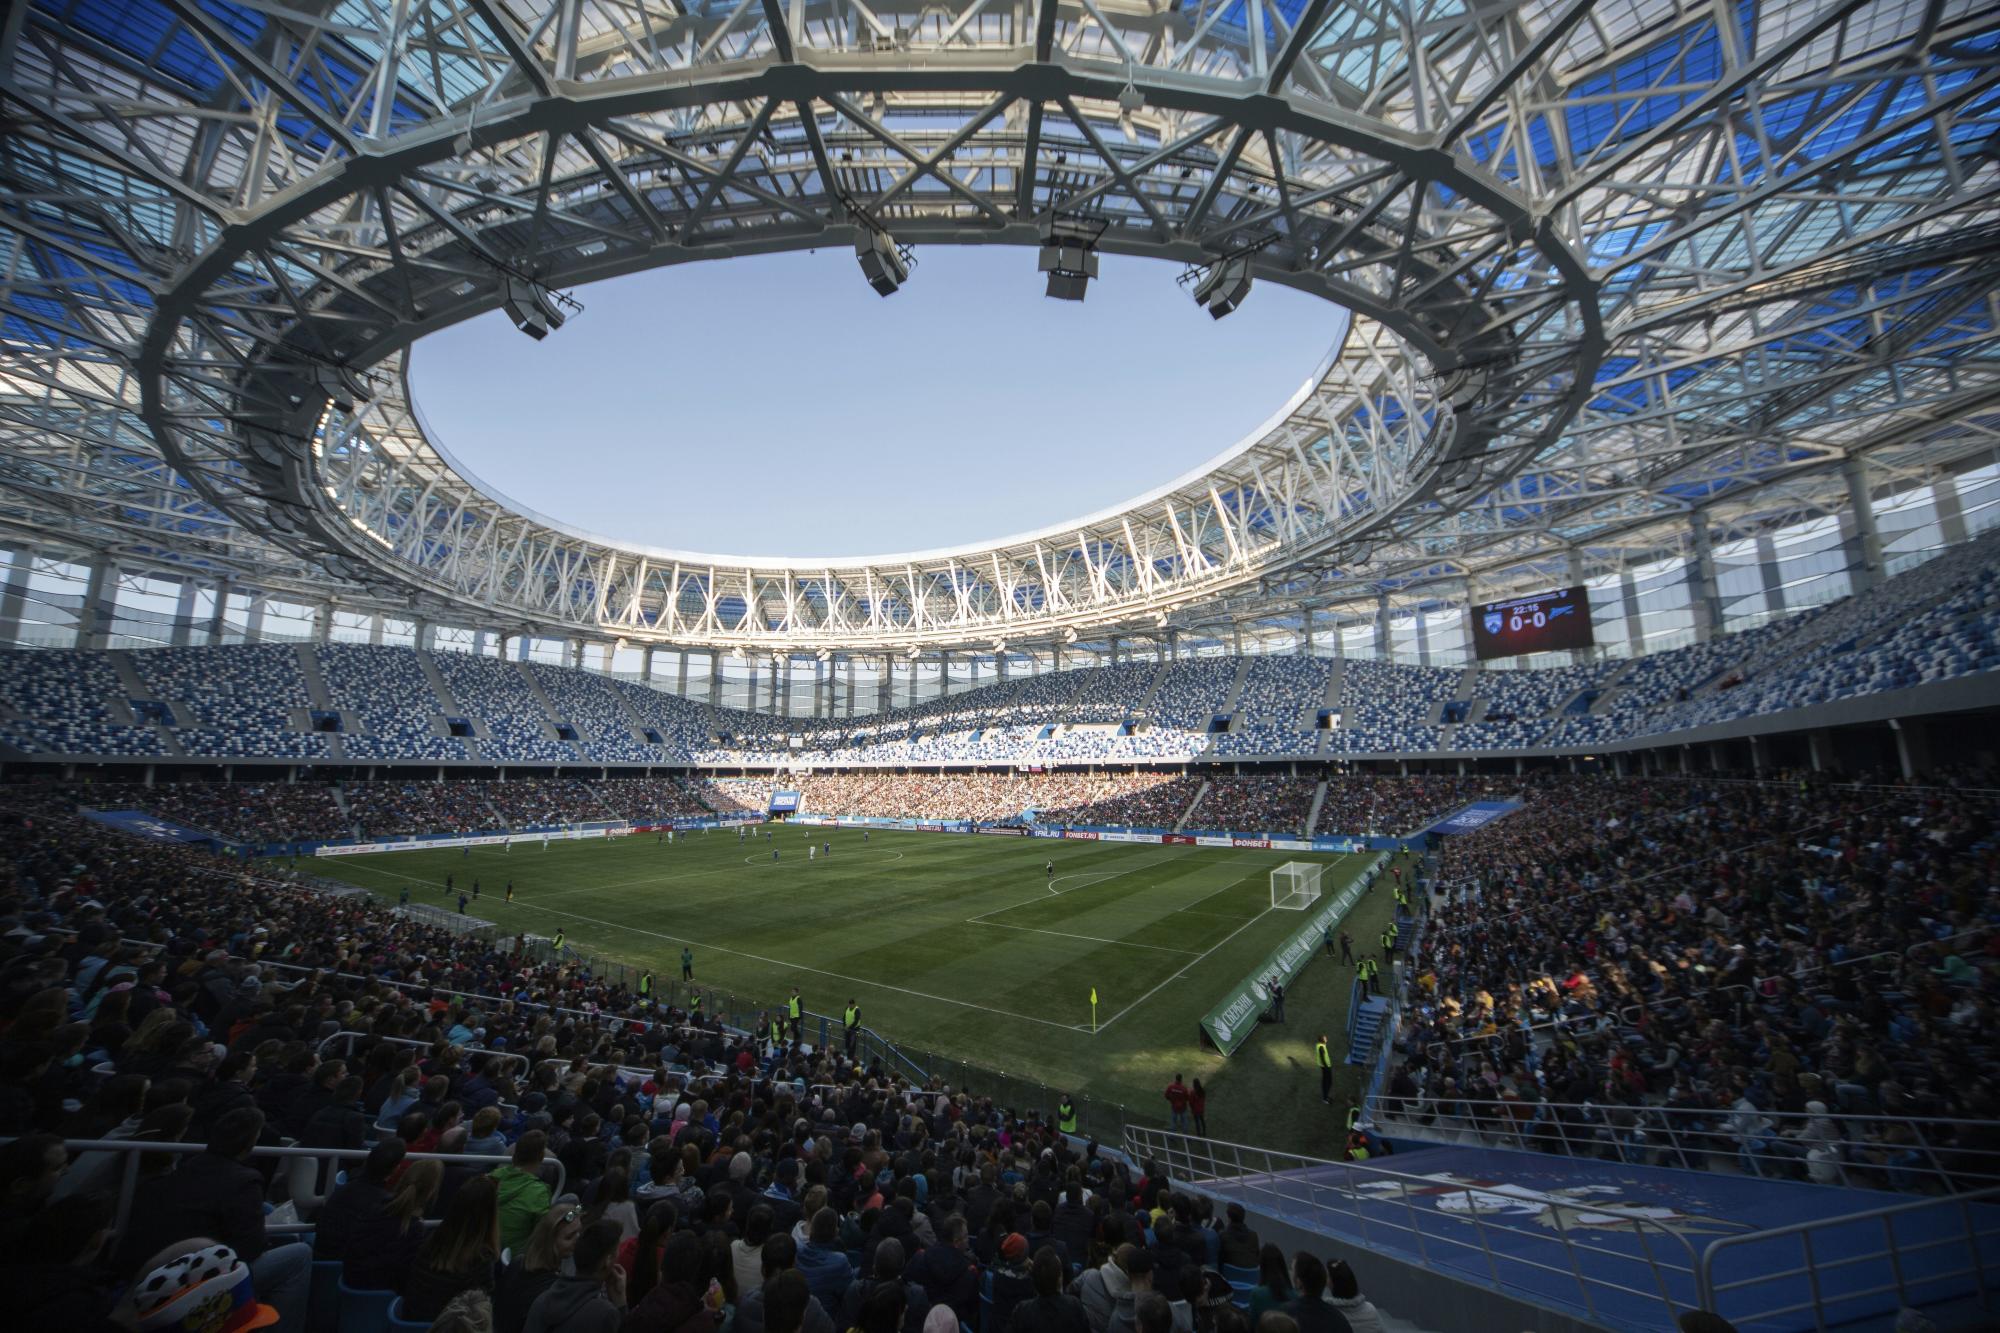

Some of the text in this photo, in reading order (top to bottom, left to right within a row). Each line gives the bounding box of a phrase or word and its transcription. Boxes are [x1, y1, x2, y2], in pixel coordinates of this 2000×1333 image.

[1034, 830, 1060, 838] 1FNL.RU
[1065, 831, 1097, 840] FONBET.RU
[1234, 839, 1269, 848] ФОНБЕТ
[1222, 993, 1254, 1027] СБЕРБАНК
